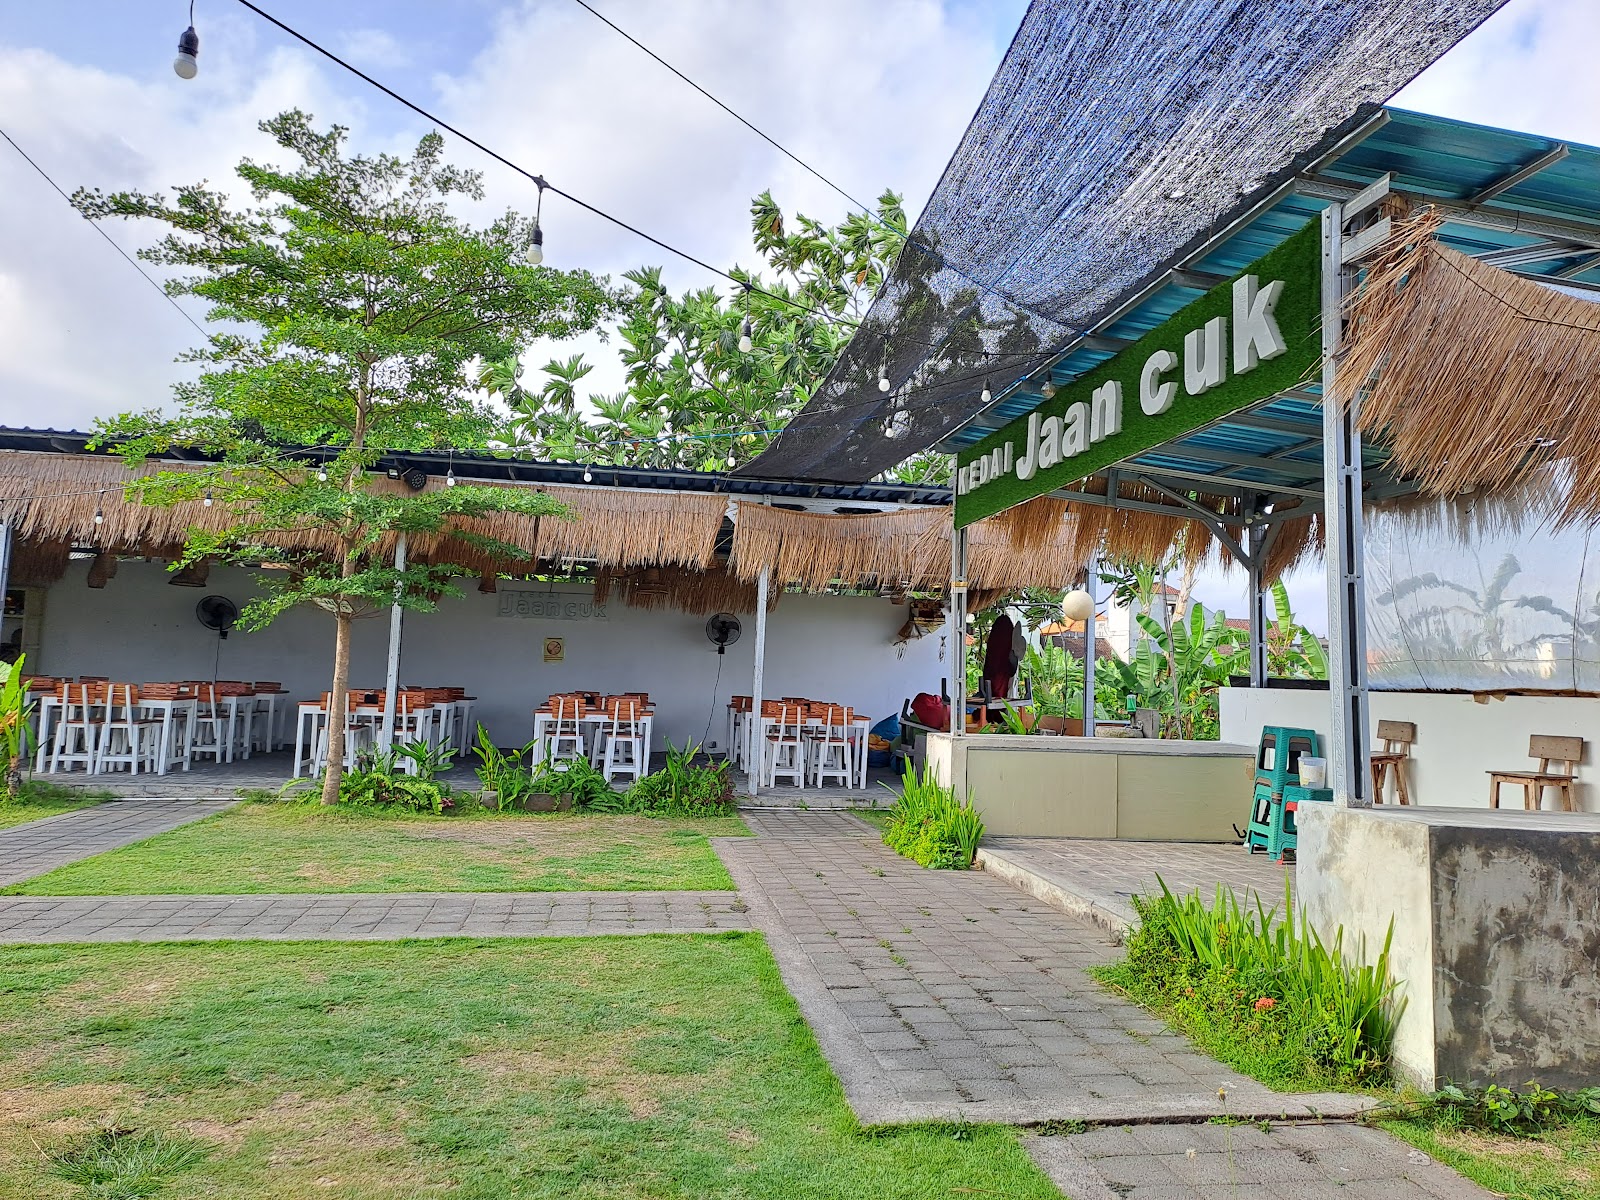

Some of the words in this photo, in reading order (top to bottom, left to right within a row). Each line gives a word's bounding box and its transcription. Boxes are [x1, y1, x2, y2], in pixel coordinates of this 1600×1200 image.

[957, 441, 1014, 495] KEDAI
[1016, 380, 1123, 480] Jaan
[1140, 273, 1288, 415] cuk
